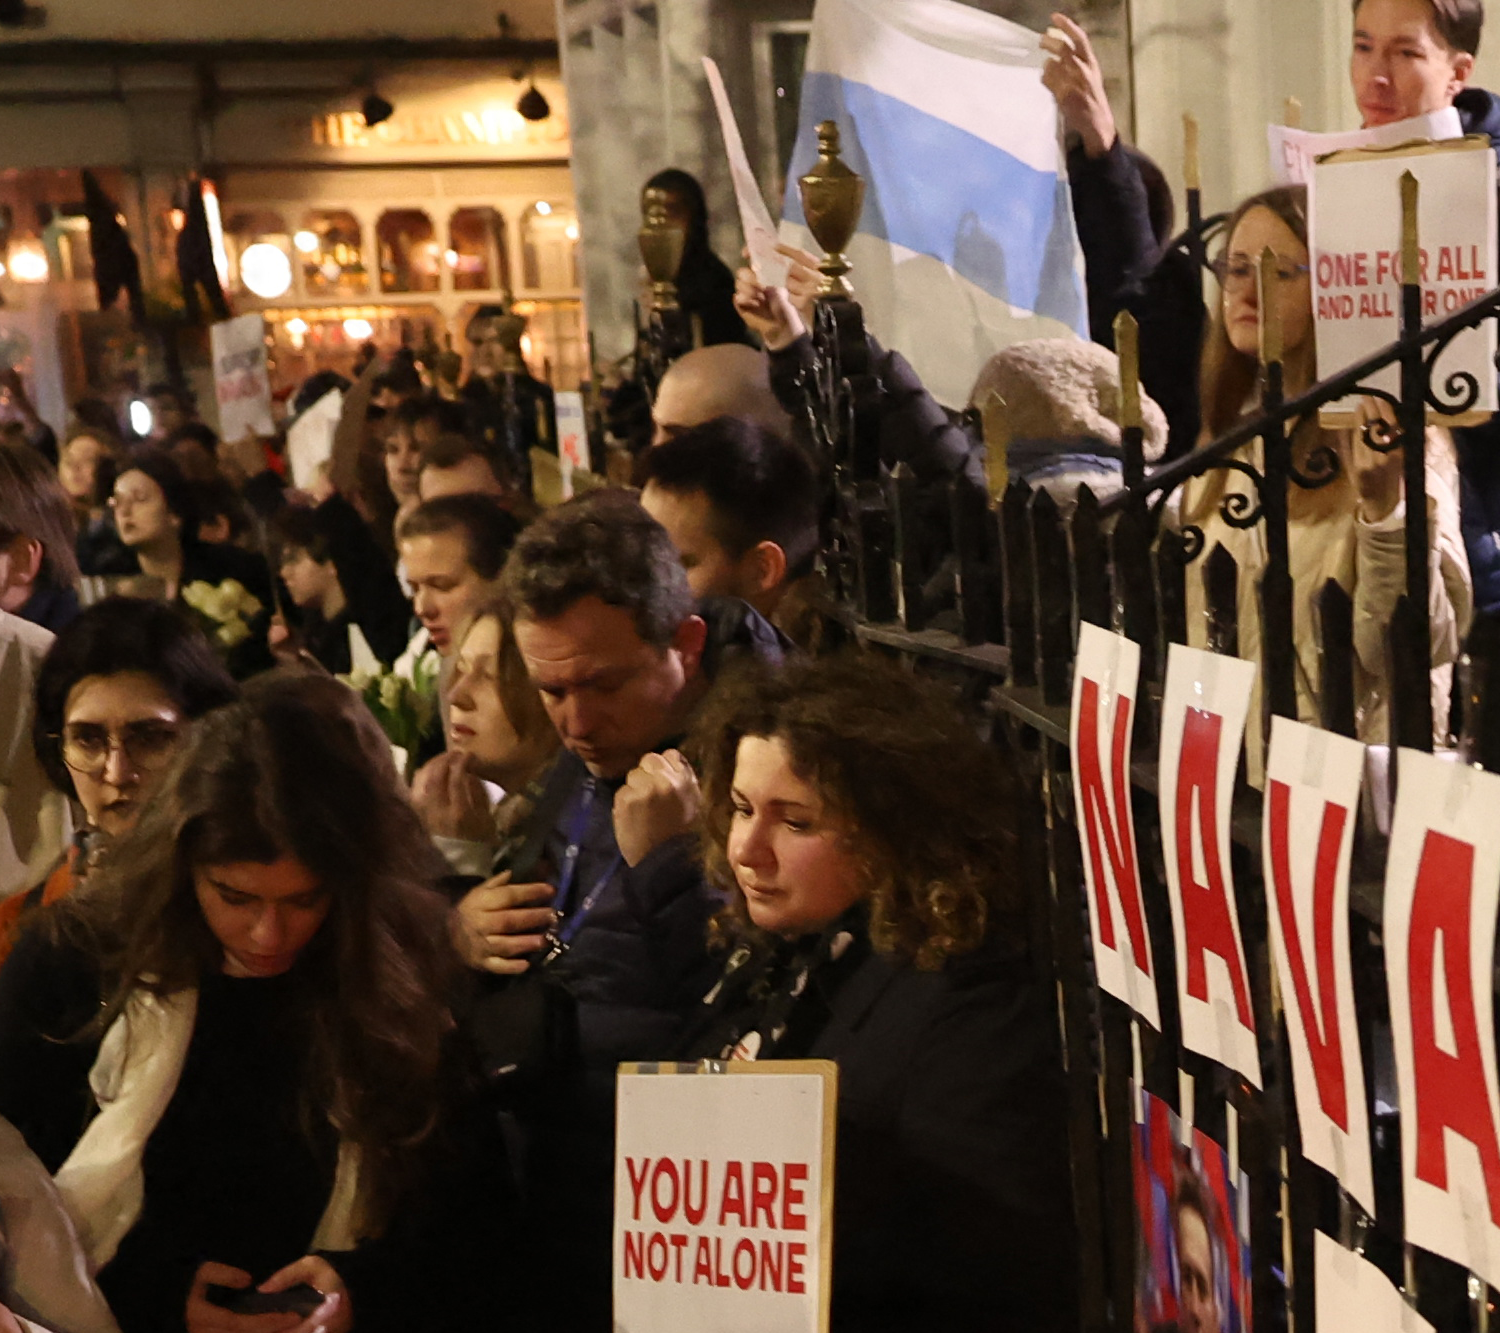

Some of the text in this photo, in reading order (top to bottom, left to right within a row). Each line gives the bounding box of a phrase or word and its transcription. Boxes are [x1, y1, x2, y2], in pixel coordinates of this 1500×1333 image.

[1316, 253, 1368, 289] ONE
[1437, 244, 1486, 281] ALL
[1318, 296, 1354, 320] AND
[1359, 293, 1394, 318] ALL
[624, 1156, 809, 1232] YOU ARE
[623, 1230, 807, 1295] NOT ALONE
